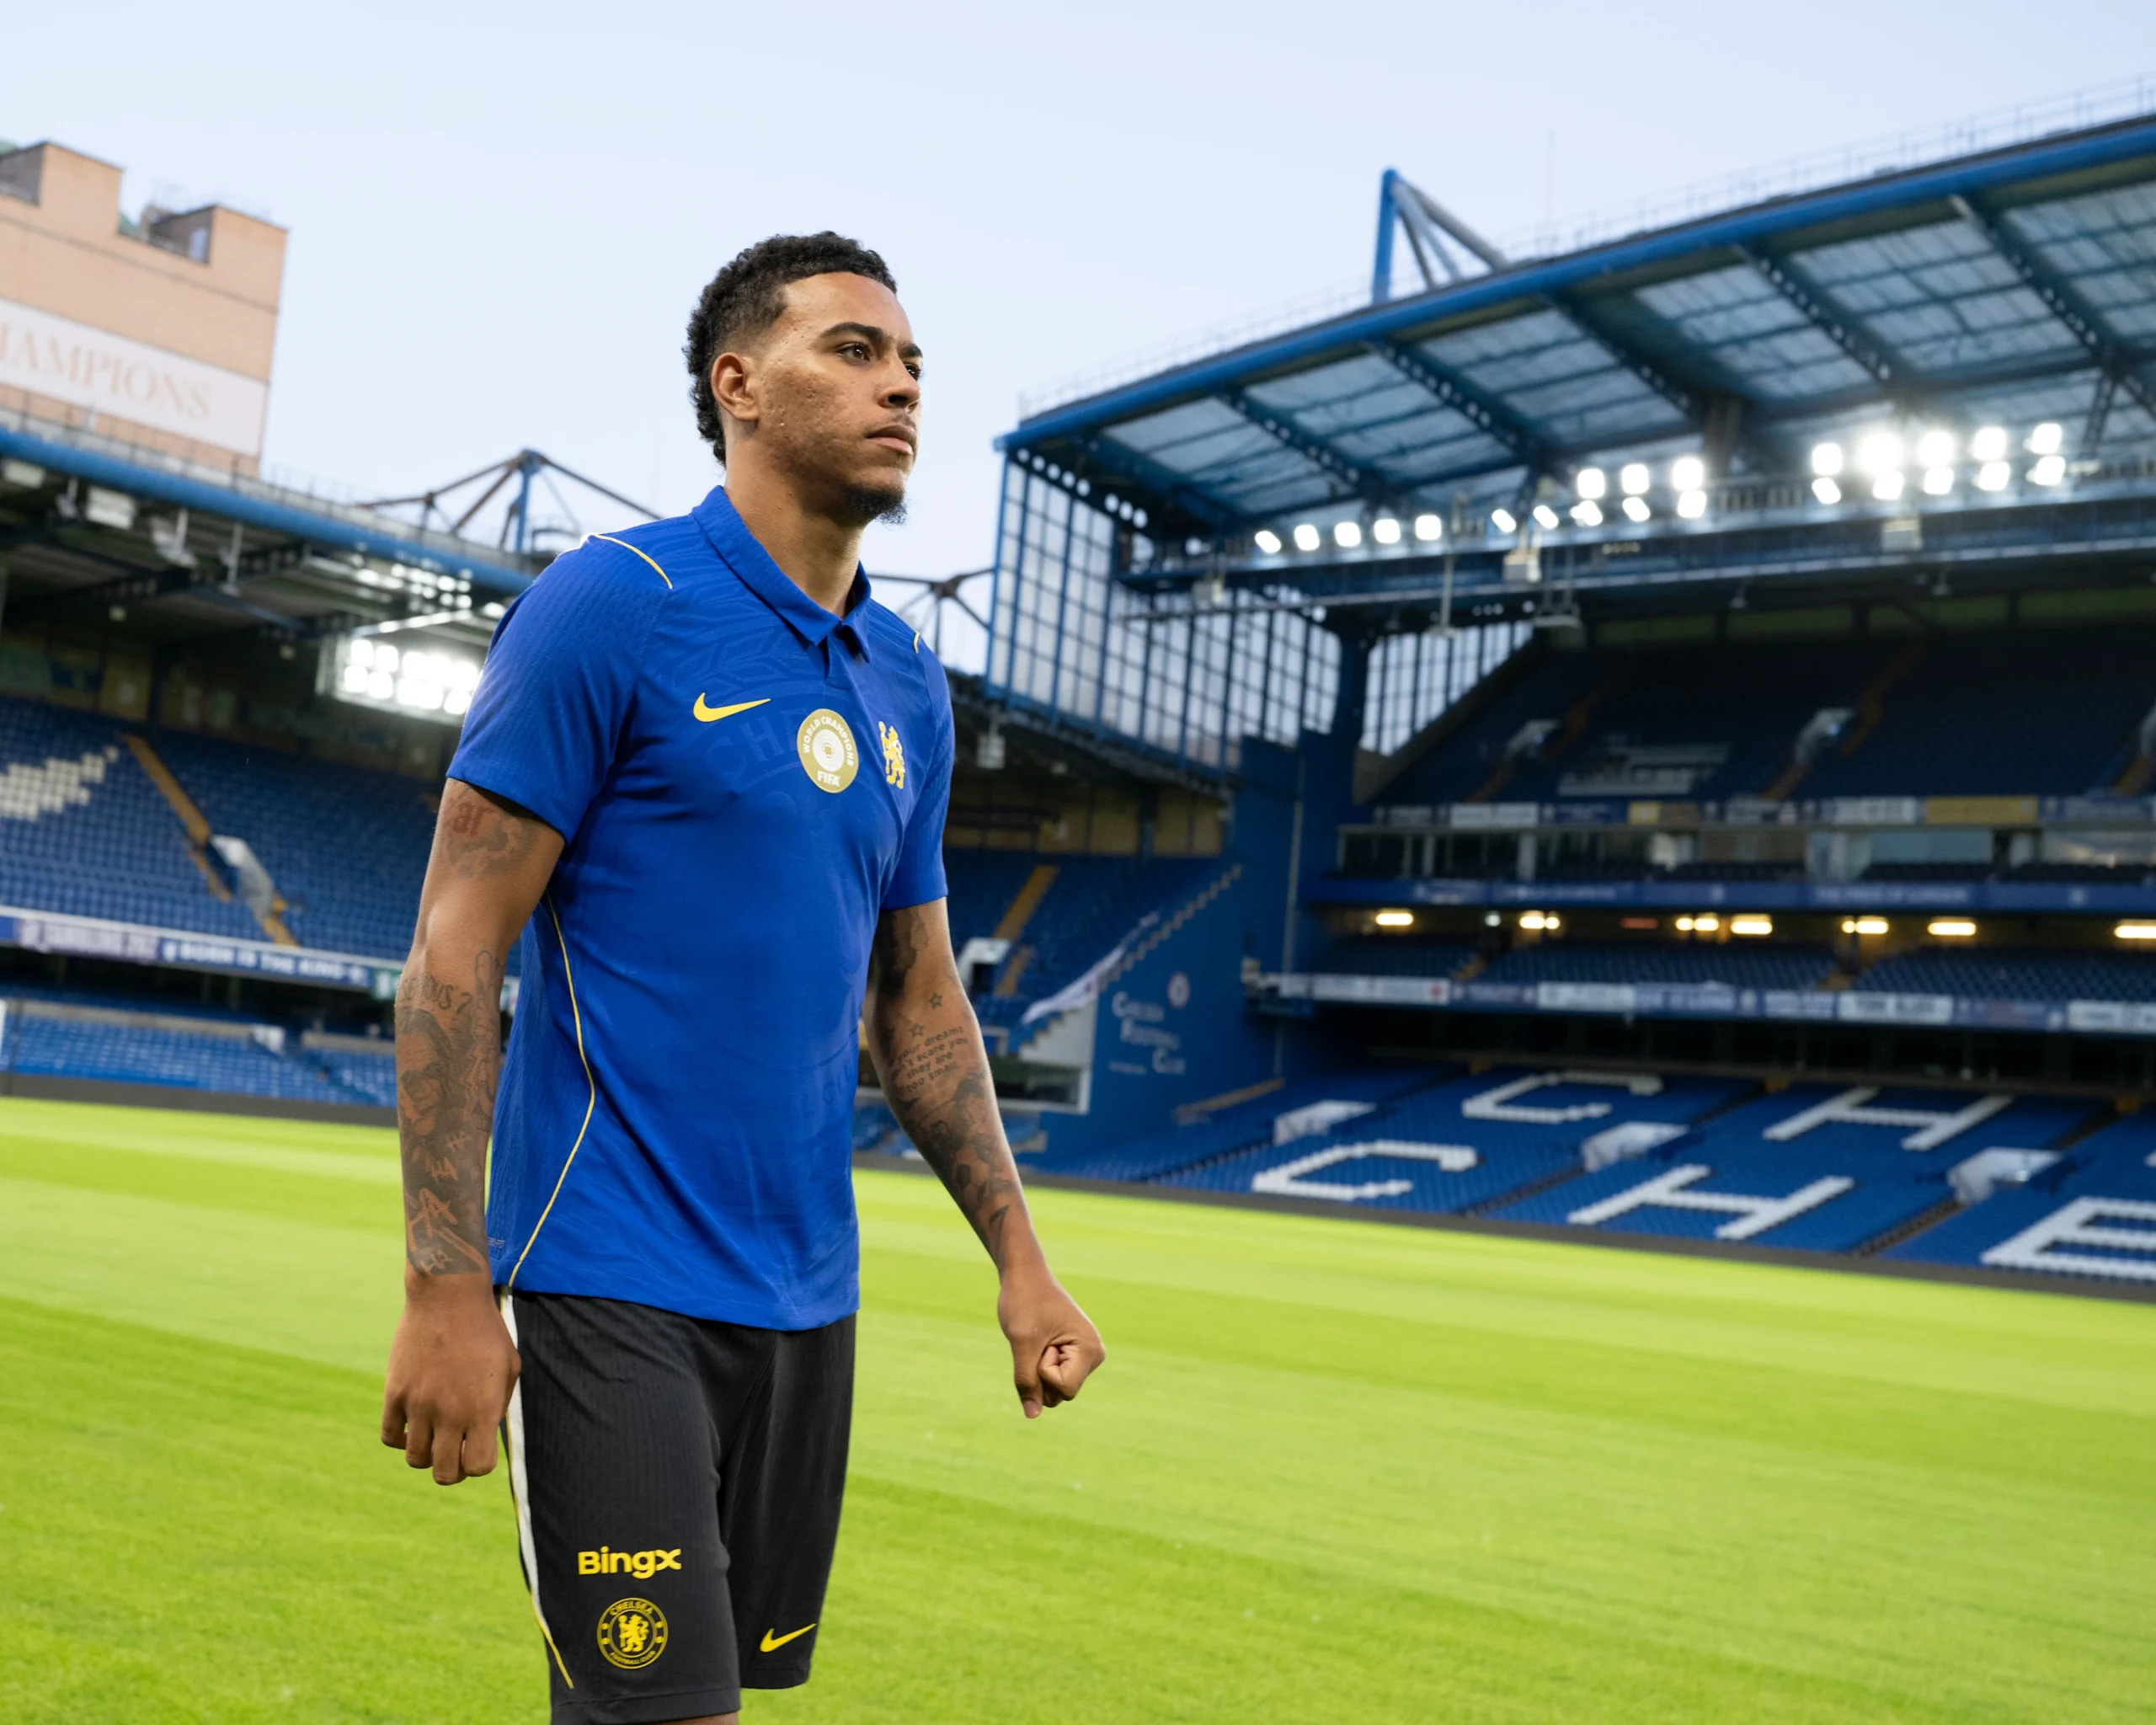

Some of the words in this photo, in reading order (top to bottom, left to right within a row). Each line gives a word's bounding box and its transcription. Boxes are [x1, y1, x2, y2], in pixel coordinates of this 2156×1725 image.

[803, 718, 821, 754] WORLD
[820, 716, 855, 767] CHAMPIONS
[817, 770, 841, 788] FIFA
[925, 1027, 964, 1046] dreams
[916, 1044, 945, 1061] scare
[936, 1051, 953, 1064] are
[906, 1077, 925, 1092] too
[609, 1601, 654, 1616] CHELSEA
